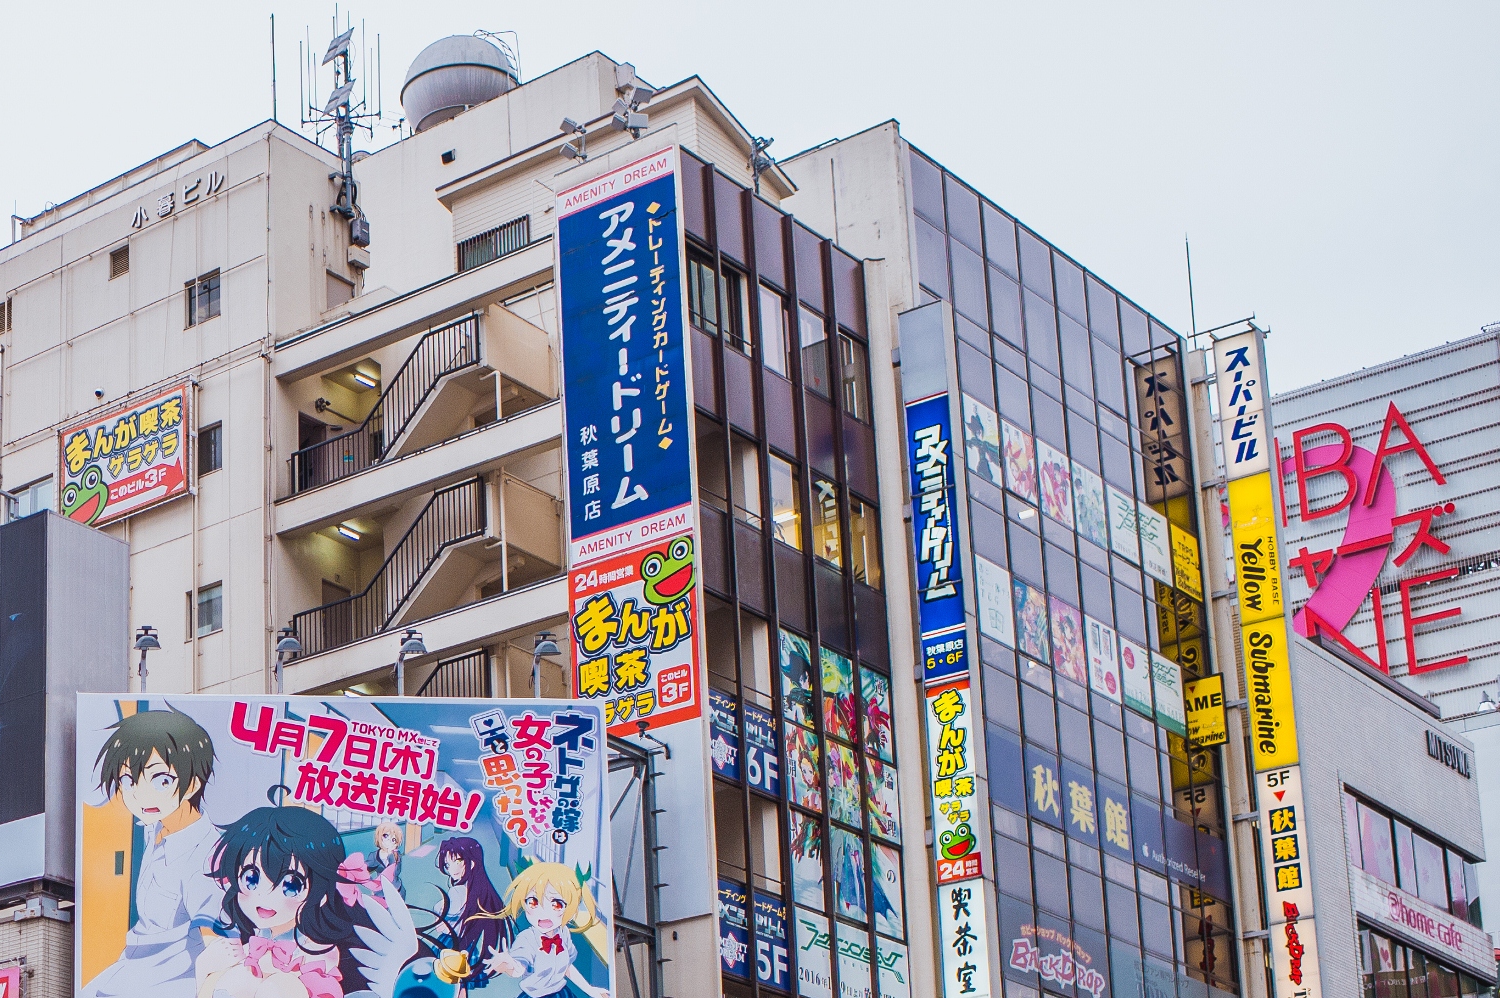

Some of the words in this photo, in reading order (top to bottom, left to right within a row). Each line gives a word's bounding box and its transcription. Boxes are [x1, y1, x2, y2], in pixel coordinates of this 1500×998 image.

[564, 180, 620, 210] AMENITY
[622, 157, 668, 190] DREAM
[1224, 345, 1260, 465] スーパービル
[64, 395, 182, 475] まんが喫茶
[107, 431, 179, 479] ゲラゲラ
[579, 424, 602, 521] 秋葉原店
[578, 530, 634, 558] AMENITY
[639, 512, 687, 542] DREAM
[1267, 535, 1276, 573] HOBBY
[573, 564, 635, 595] 24時間営業
[1238, 536, 1264, 613] Yellow
[1271, 577, 1280, 605] BASE
[575, 591, 693, 653] まんが
[579, 644, 649, 696] 喫茶
[660, 681, 690, 706] 3F
[1249, 630, 1277, 756] Submarine
[351, 720, 396, 740] TOKYO
[931, 689, 967, 779] まんが
[296, 763, 485, 832] 放送開始!
[510, 713, 554, 835] 女の子じゃない
[551, 713, 597, 845] ネトゲの嫁は
[747, 747, 779, 795] 6F
[934, 776, 975, 800] 喫茶
[1266, 769, 1291, 788] 5F
[1031, 763, 1131, 851] 秋葉館
[940, 859, 965, 878] 24
[1269, 805, 1302, 892] 秋葉館
[951, 887, 978, 994] 喫茶室
[1387, 890, 1435, 937] @home
[1437, 923, 1463, 951] cafe
[757, 940, 790, 983] 5F
